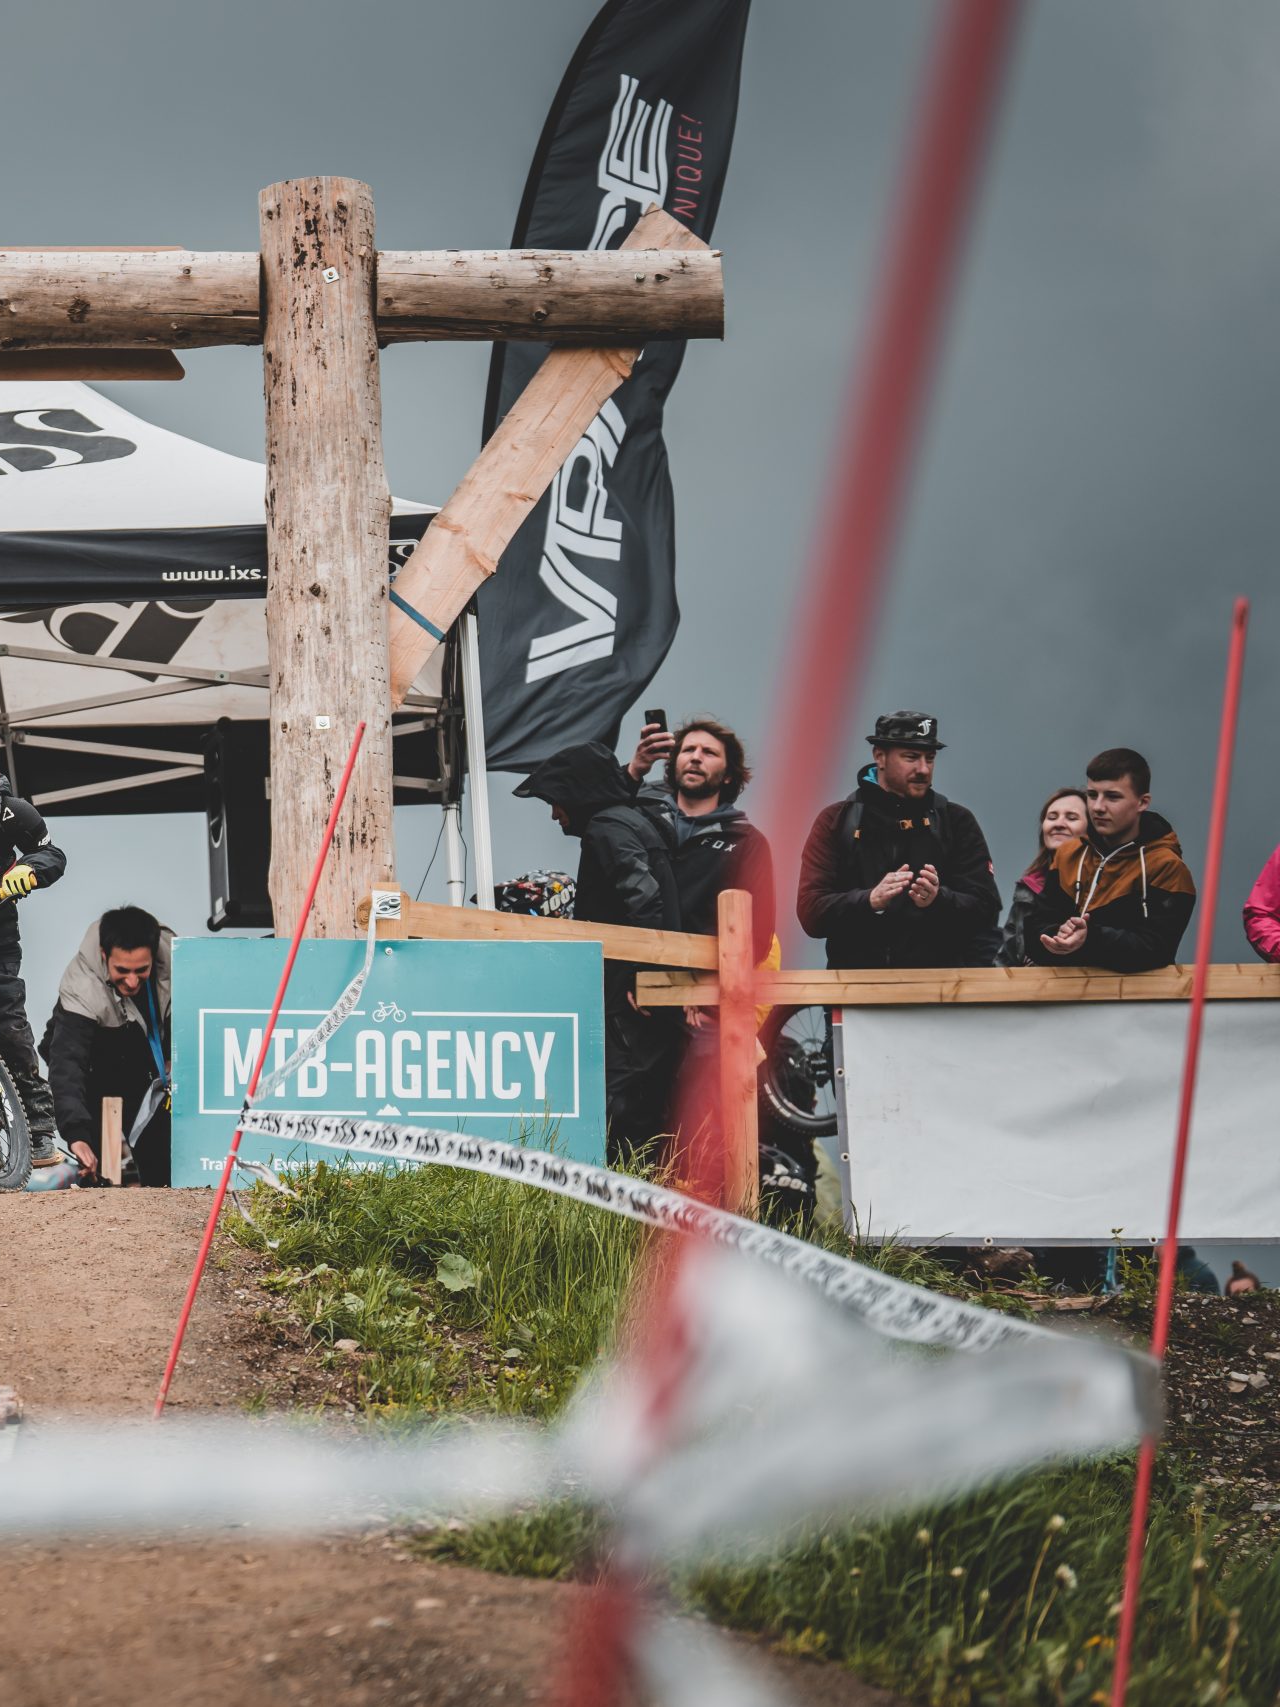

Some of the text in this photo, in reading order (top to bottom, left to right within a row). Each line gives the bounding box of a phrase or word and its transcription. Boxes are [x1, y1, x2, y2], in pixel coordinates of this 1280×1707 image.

[673, 114, 704, 219] NIQUE!
[162, 565, 267, 581] www.ixs.
[700, 837, 737, 852] FOX
[223, 1027, 556, 1100] MTB-AGENCY
